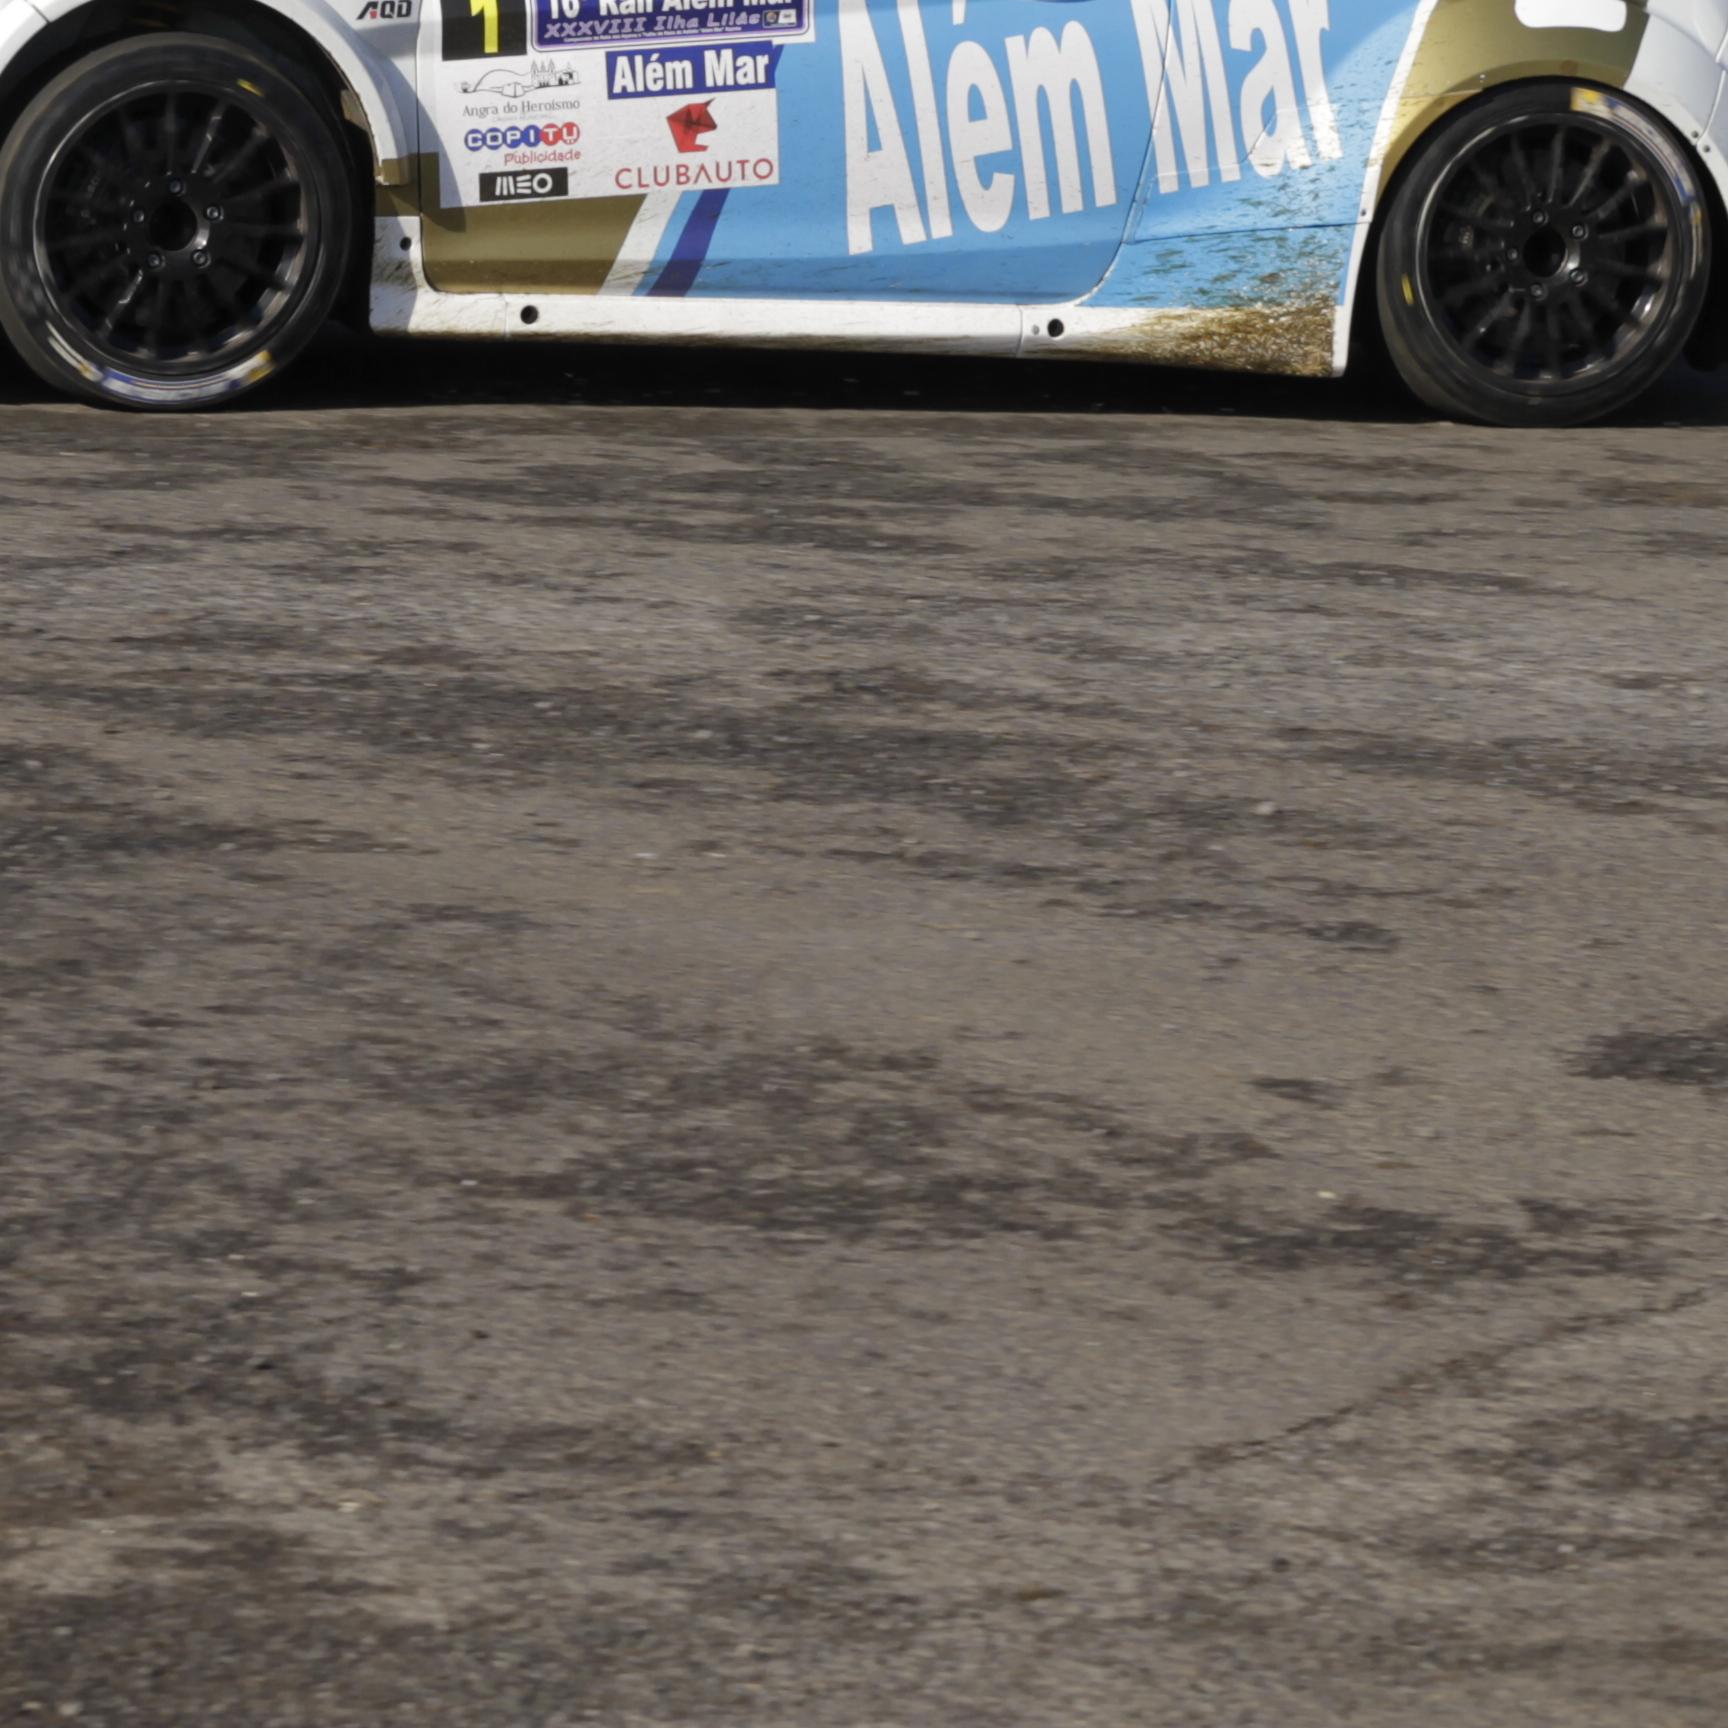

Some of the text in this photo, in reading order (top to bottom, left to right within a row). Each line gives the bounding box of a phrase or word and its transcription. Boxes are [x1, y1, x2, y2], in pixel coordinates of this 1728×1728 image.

[654, 13, 699, 32] Ilha
[613, 48, 769, 93] Além Mar
[462, 105, 498, 118] Angra
[503, 101, 518, 113] do
[504, 149, 581, 166] Publicidade
[615, 158, 774, 189] CLUBAUTO
[495, 173, 553, 196] MEO
